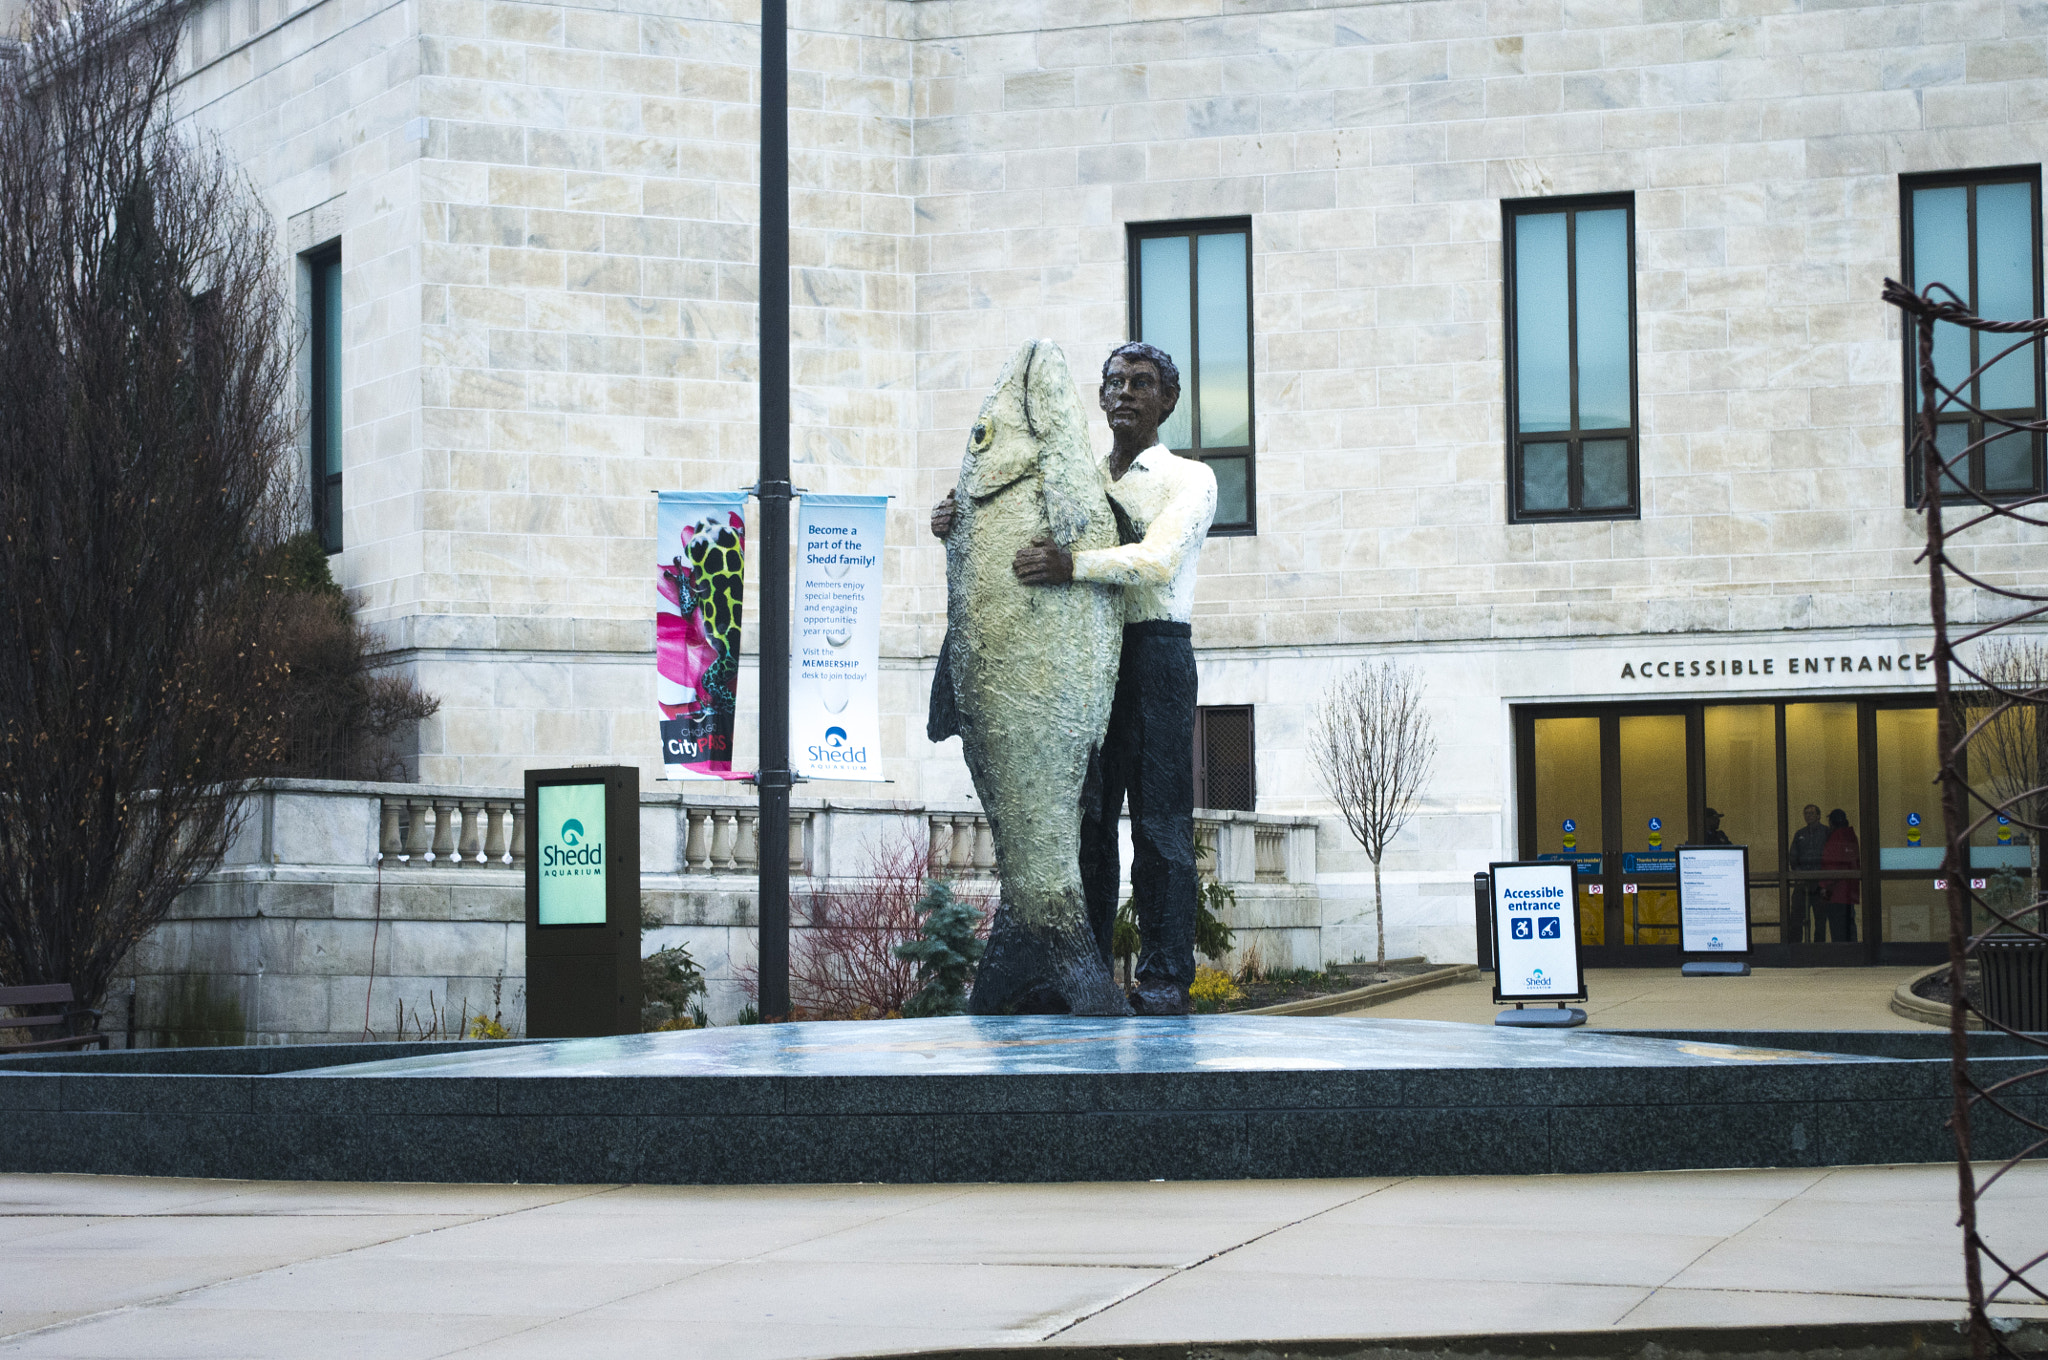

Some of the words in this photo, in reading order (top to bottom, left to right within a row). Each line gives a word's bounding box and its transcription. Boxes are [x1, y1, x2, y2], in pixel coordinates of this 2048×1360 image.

[808, 525, 848, 535] Become
[808, 540, 828, 552] part
[832, 540, 842, 549] of
[845, 540, 862, 550] the
[807, 554, 837, 564] Shedd
[840, 554, 875, 568] family!
[806, 580, 841, 588] Members
[843, 582, 865, 591] enjoy
[805, 592, 830, 601] special
[821, 605, 858, 614] engaging
[804, 616, 857, 625] opportunities
[803, 628, 820, 637] year
[802, 648, 819, 656] Visit
[822, 648, 834, 656] the
[802, 660, 859, 668] MEMBERSHIP
[1620, 658, 1774, 679] ACCESSIBLE
[1788, 653, 1927, 674] ENTRANCE
[829, 673, 842, 681] join
[844, 673, 867, 681] today!
[681, 723, 717, 737] CHCAGO
[808, 746, 866, 763] Shedd
[543, 844, 602, 866] Shedd
[544, 868, 601, 877] AQUARIUM
[1504, 886, 1564, 898] Accessible
[1508, 901, 1560, 911] entrance
[1526, 977, 1551, 986] Shedd
